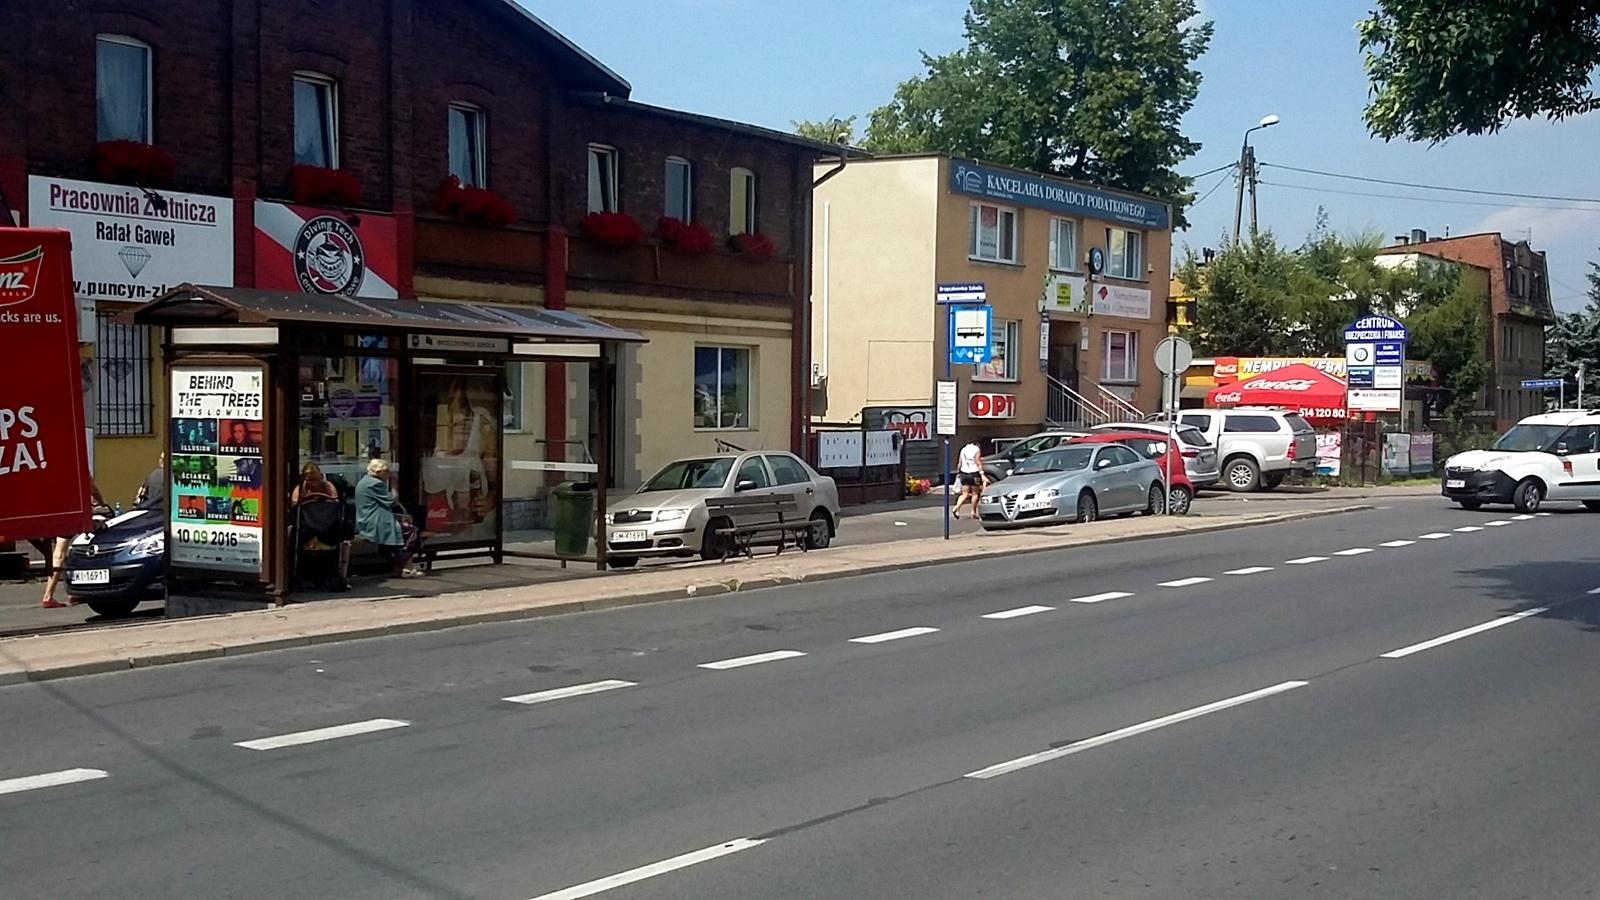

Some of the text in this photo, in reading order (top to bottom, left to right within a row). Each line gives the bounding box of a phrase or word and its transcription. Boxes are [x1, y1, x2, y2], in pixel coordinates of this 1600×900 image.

[50, 183, 139, 215] Pracownia
[987, 174, 1146, 218] KANCELARIA DORADCY PODATKOWEGO
[96, 221, 176, 247] Rafał Gaweł
[303, 220, 355, 245] Diving Tech
[23, 313, 42, 323] are
[45, 312, 62, 323] us.
[1355, 317, 1395, 329] CENTRUM
[189, 375, 234, 390] BEHIND
[1242, 378, 1318, 391] Coca-Cola
[178, 392, 260, 408] THE TREES
[1298, 407, 1315, 418] 514
[1315, 408, 1332, 418] 120
[177, 529, 238, 547] 10 09 2016
